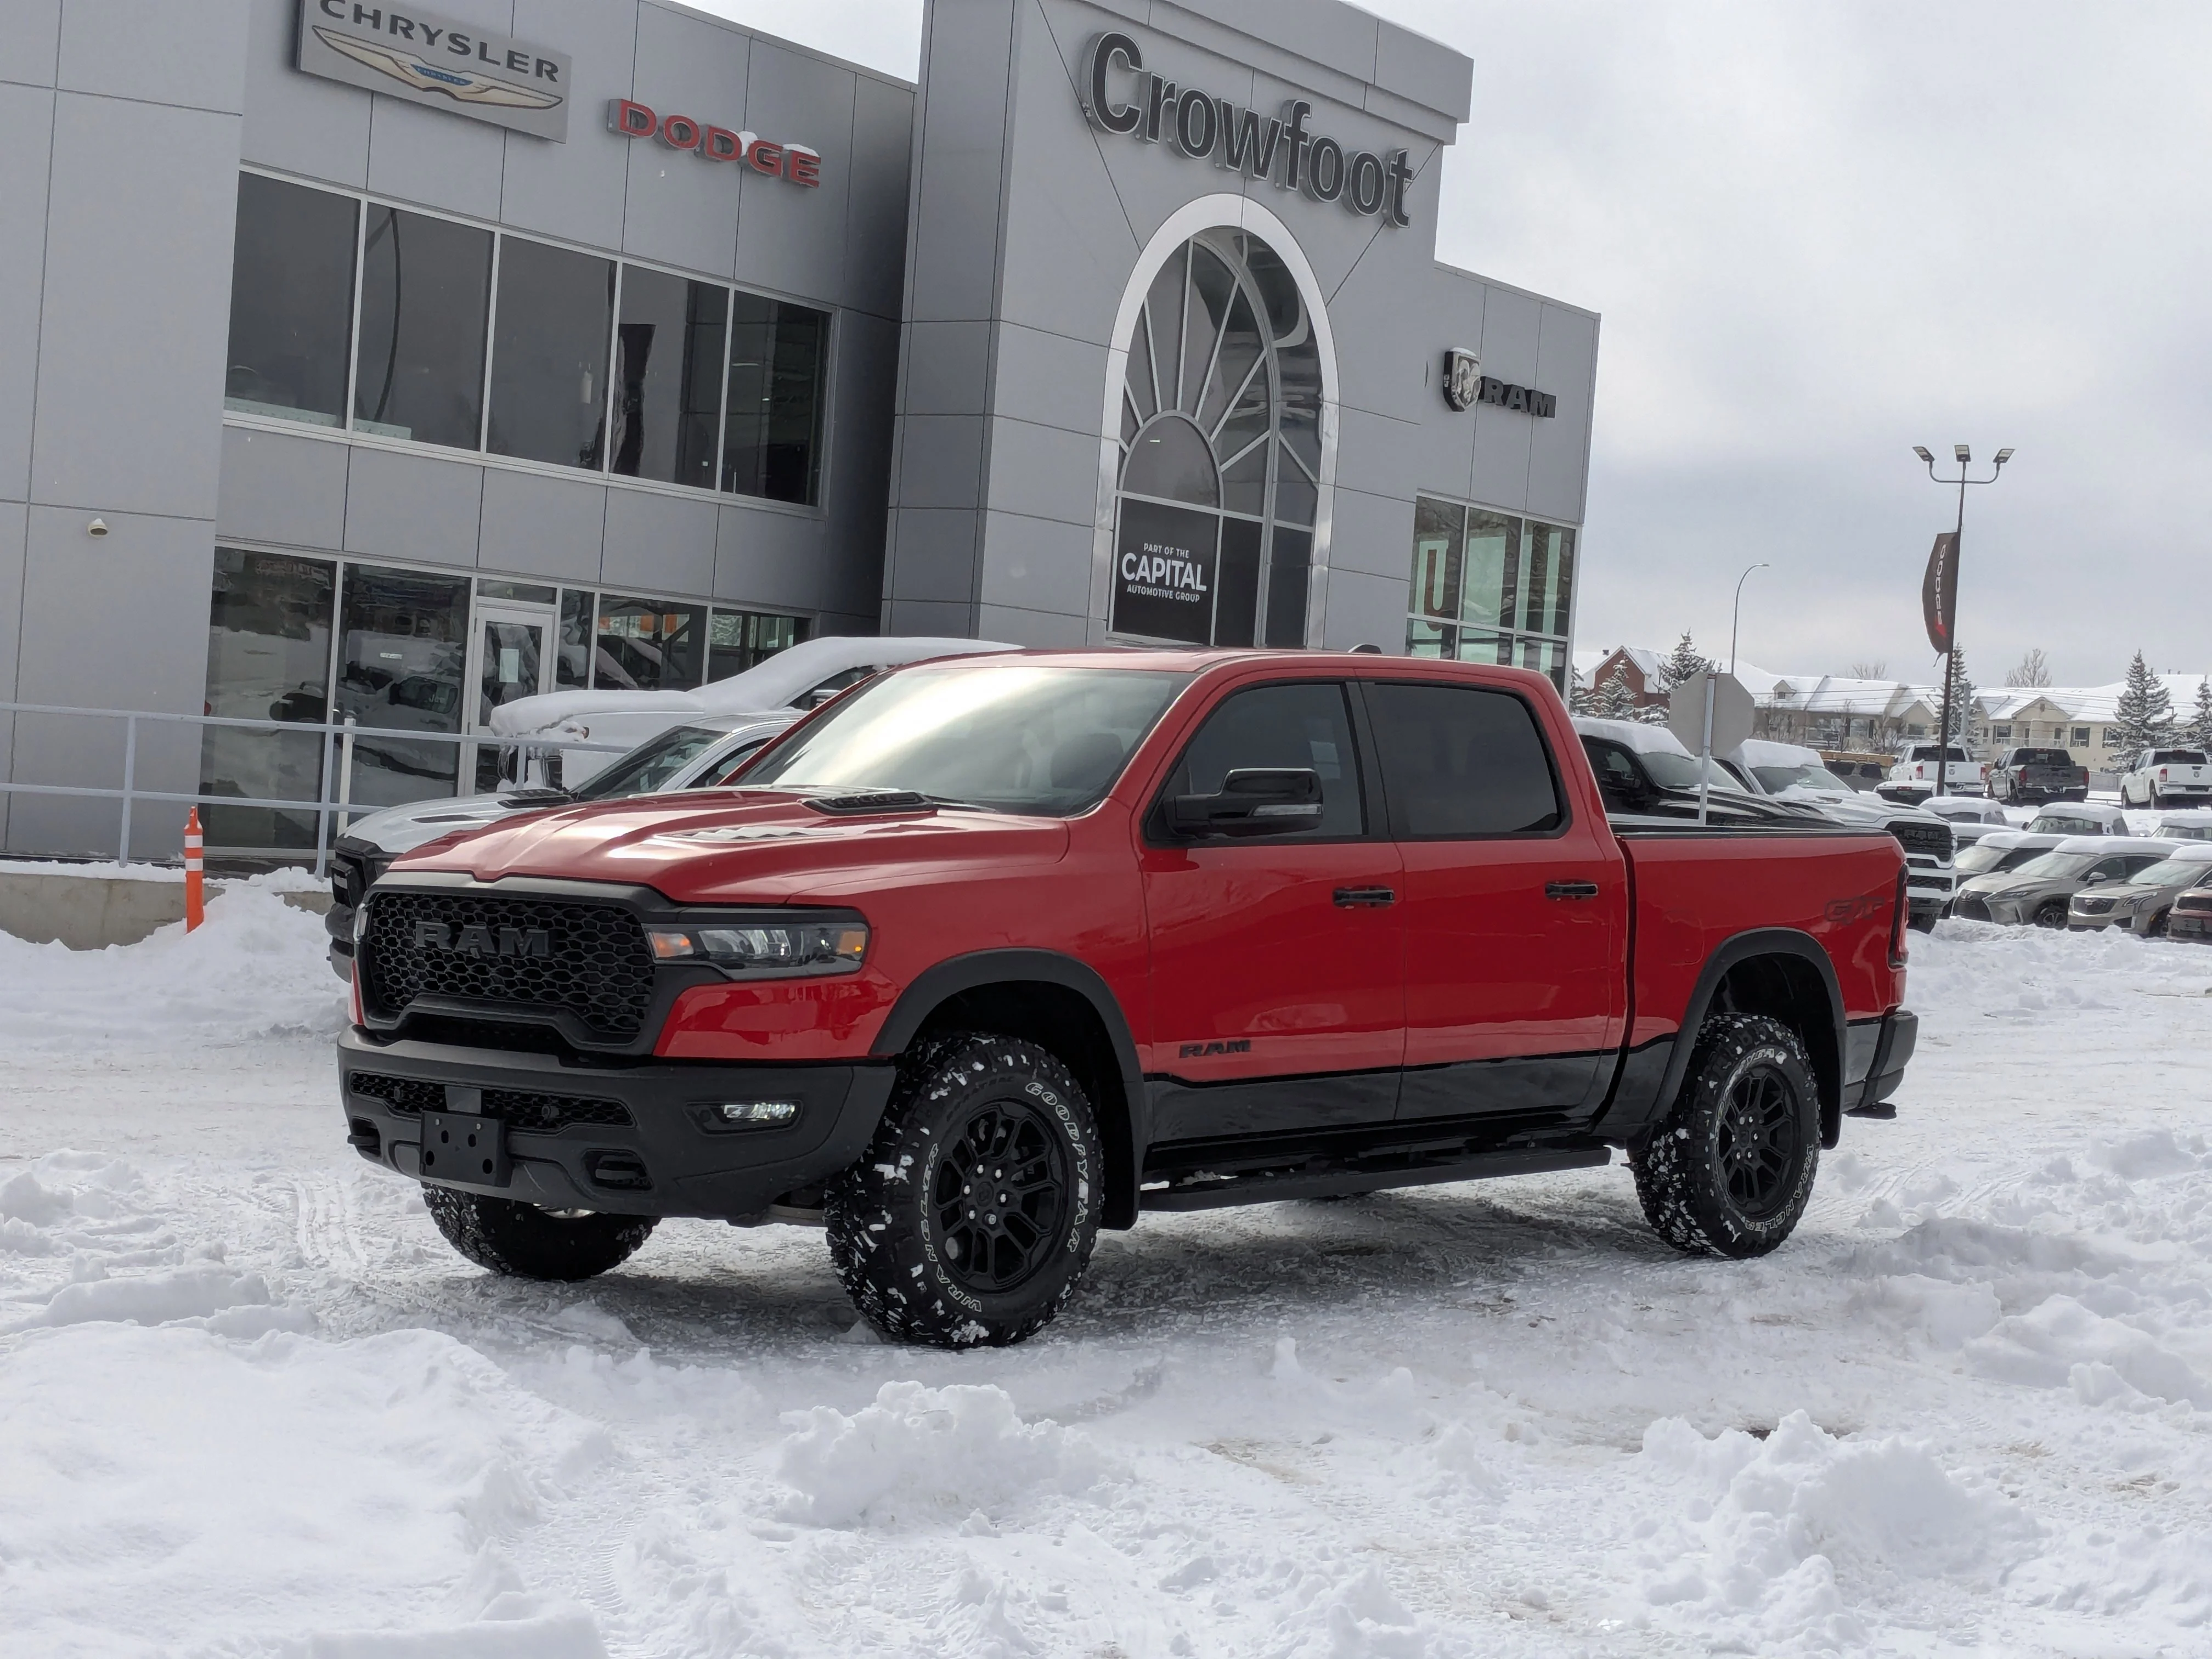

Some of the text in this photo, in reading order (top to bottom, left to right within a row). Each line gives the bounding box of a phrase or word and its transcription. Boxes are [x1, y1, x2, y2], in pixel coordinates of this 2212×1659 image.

[320, 0, 558, 82] CHRYSLER
[616, 98, 821, 188] DODGE
[1088, 31, 1414, 229] Crowfoot
[1482, 376, 1556, 419] RAM
[1121, 552, 1207, 591] CAPITAL
[1143, 543, 1190, 558] PART OF THE
[1126, 584, 1200, 603] AUTOMOTIVE GROUP
[415, 921, 549, 957] RAM
[1178, 1040, 1251, 1058] RAM
[1025, 1082, 1089, 1252] GOODYEAR
[920, 1143, 982, 1312] WRANGLER
